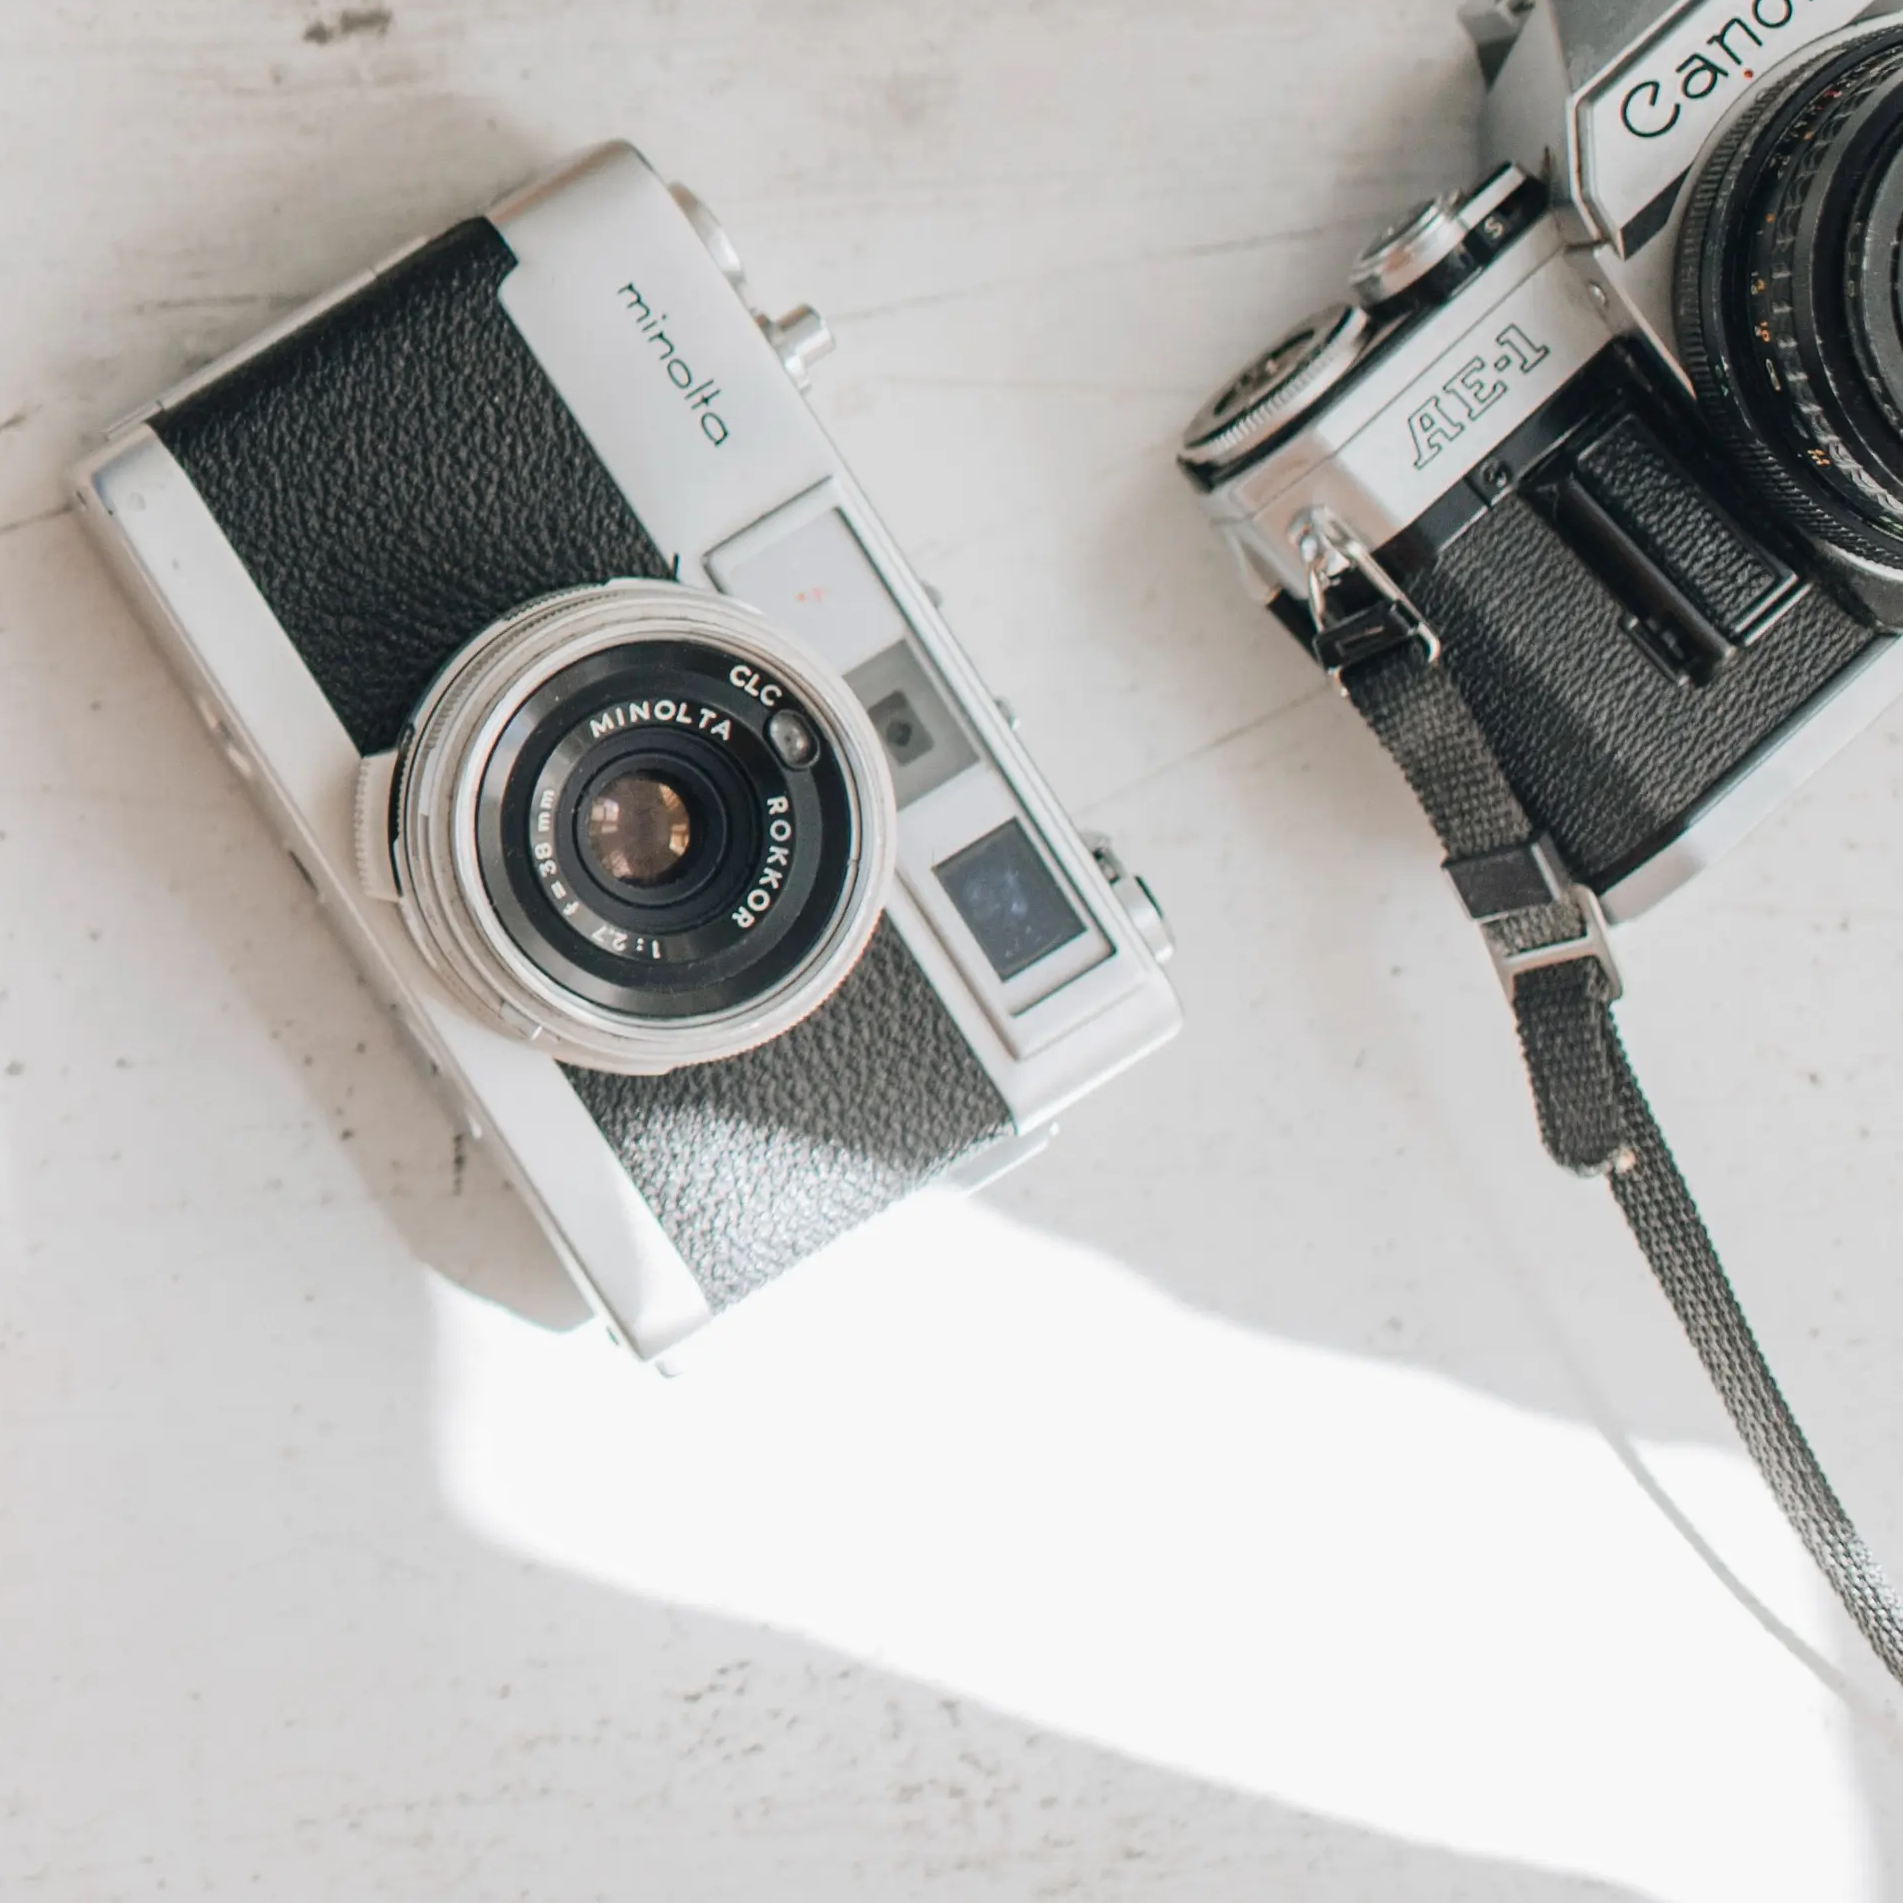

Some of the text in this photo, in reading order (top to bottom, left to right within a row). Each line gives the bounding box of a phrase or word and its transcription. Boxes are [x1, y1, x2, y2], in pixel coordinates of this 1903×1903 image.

[617, 282, 730, 448] minolta
[1405, 324, 1549, 470] AE-1
[728, 664, 783, 708] CLC
[589, 699, 733, 741] MINOLTA
[731, 795, 792, 930] ROKKOR
